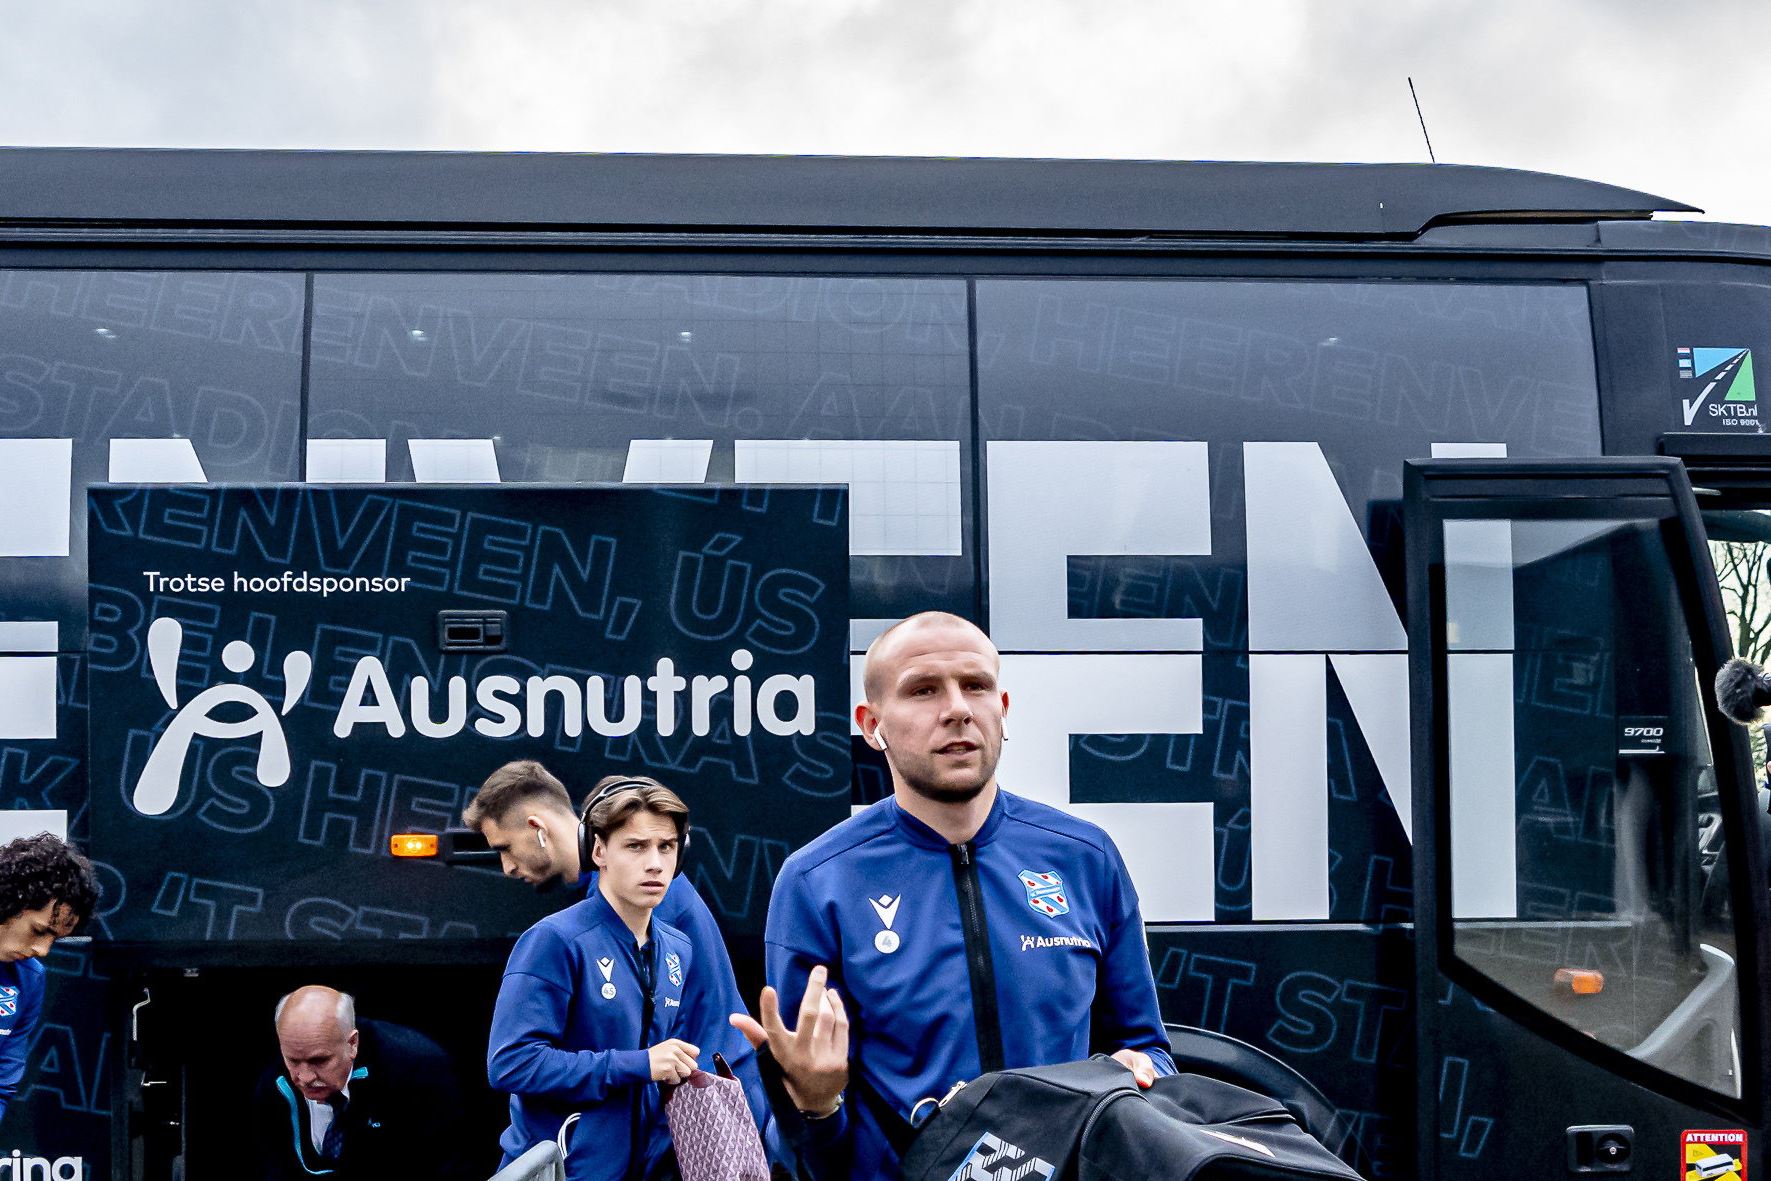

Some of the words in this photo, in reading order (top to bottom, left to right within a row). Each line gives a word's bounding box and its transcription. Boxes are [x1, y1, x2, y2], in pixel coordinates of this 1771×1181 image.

[1709, 404, 1758, 416] SKTB.nl
[143, 571, 226, 594] Trotse
[232, 570, 411, 598] hoofdsponsor
[333, 648, 816, 740] Ausnutria
[1624, 727, 1664, 736] 9700
[881, 932, 892, 947] 4
[603, 986, 615, 996] 45
[1686, 1133, 1743, 1142] ATTENTION
